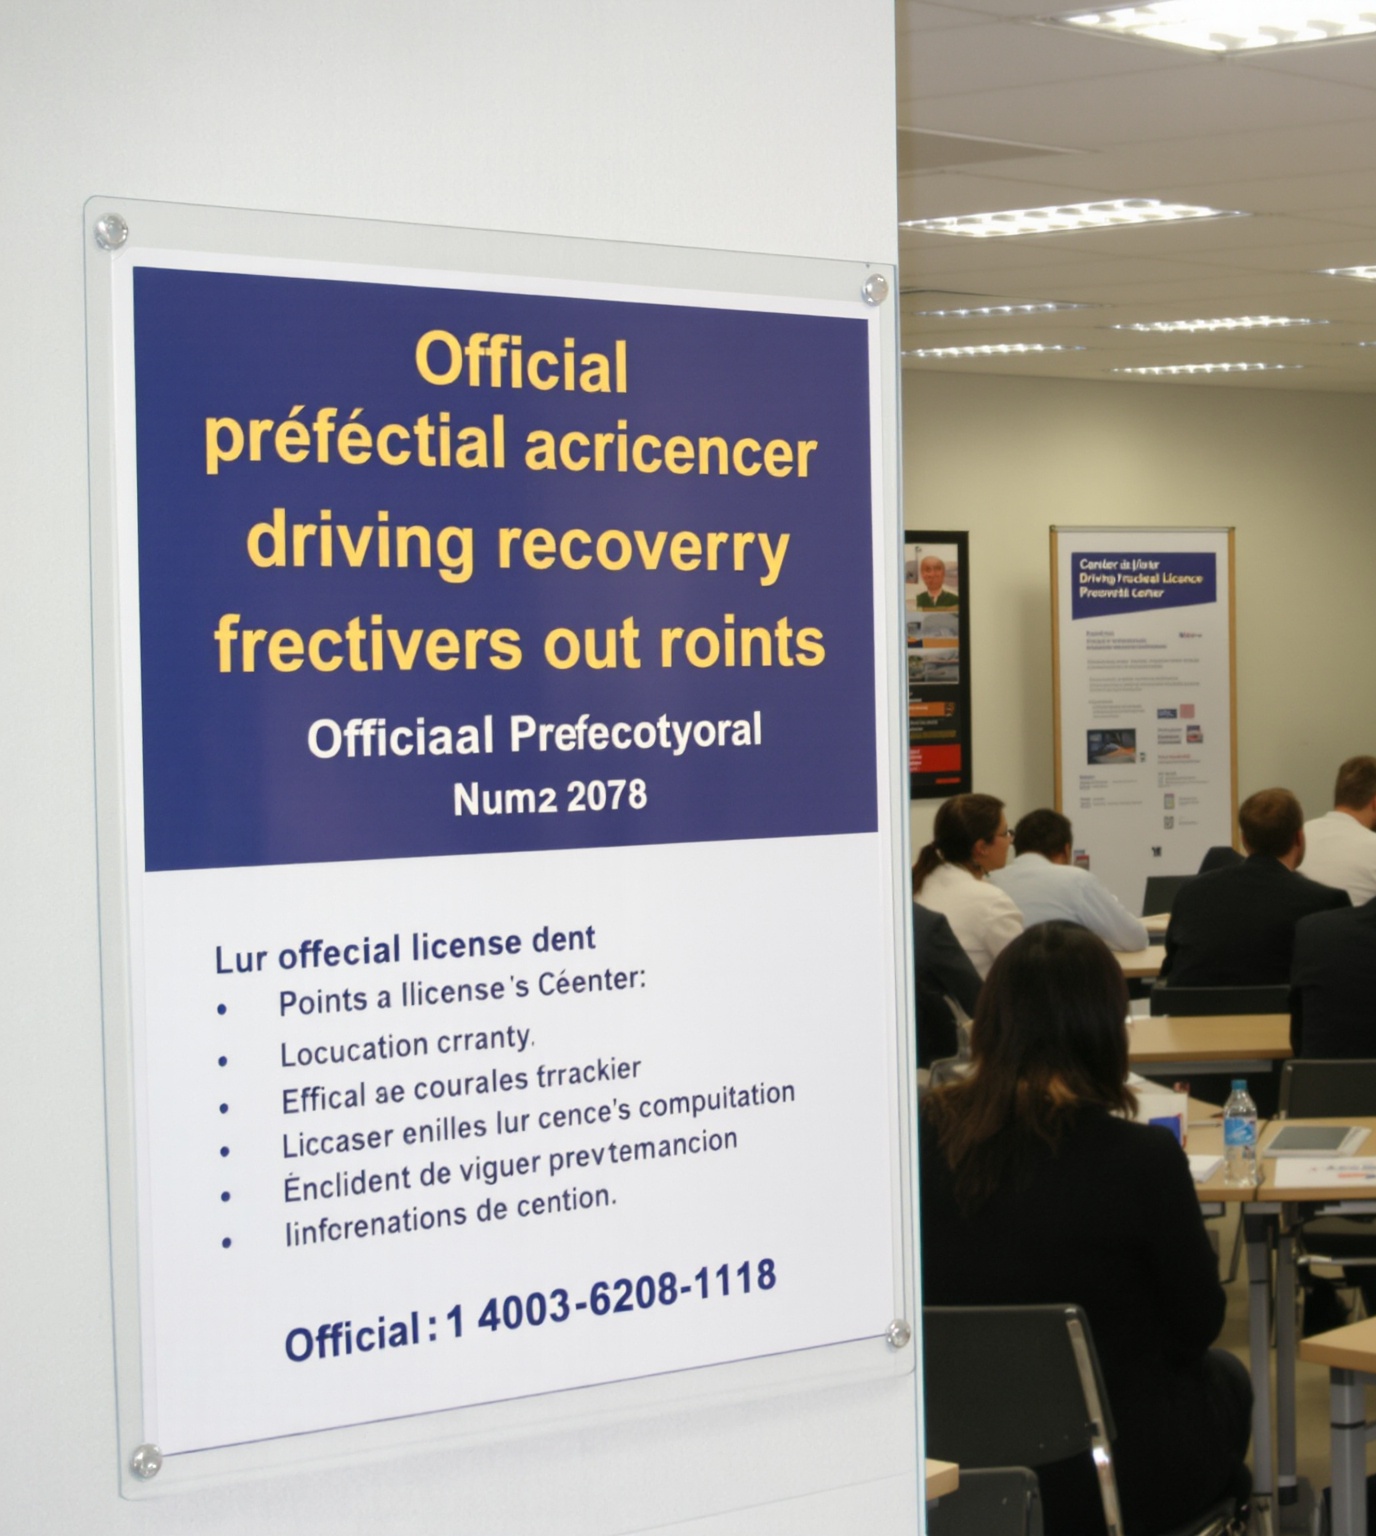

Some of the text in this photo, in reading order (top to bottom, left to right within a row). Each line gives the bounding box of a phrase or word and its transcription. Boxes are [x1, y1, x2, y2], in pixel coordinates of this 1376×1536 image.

[415, 329, 627, 394] Official
[205, 404, 819, 478] préféctial acricencer
[246, 507, 791, 587] driving recoverry
[213, 613, 826, 673] frectivers out roints
[307, 710, 762, 759] Officiaal Prefecotyoral
[453, 778, 648, 816] Num2 2078
[215, 925, 597, 975] Lur offecial license dent
[279, 988, 368, 1017] Points
[376, 989, 392, 1009] a
[538, 968, 646, 997] Céenter:
[280, 1033, 428, 1068] Locucation
[282, 1081, 366, 1115] Effical
[375, 1084, 406, 1105] ae
[413, 1068, 529, 1101] courales
[282, 1081, 795, 1159] Liccaser enilles lur cence's compuitation
[419, 1161, 452, 1187] de
[459, 1154, 542, 1186] viguer
[476, 1197, 508, 1223] de
[517, 1186, 617, 1218] cention.
[477, 1257, 777, 1332] 4003-6208-1118
